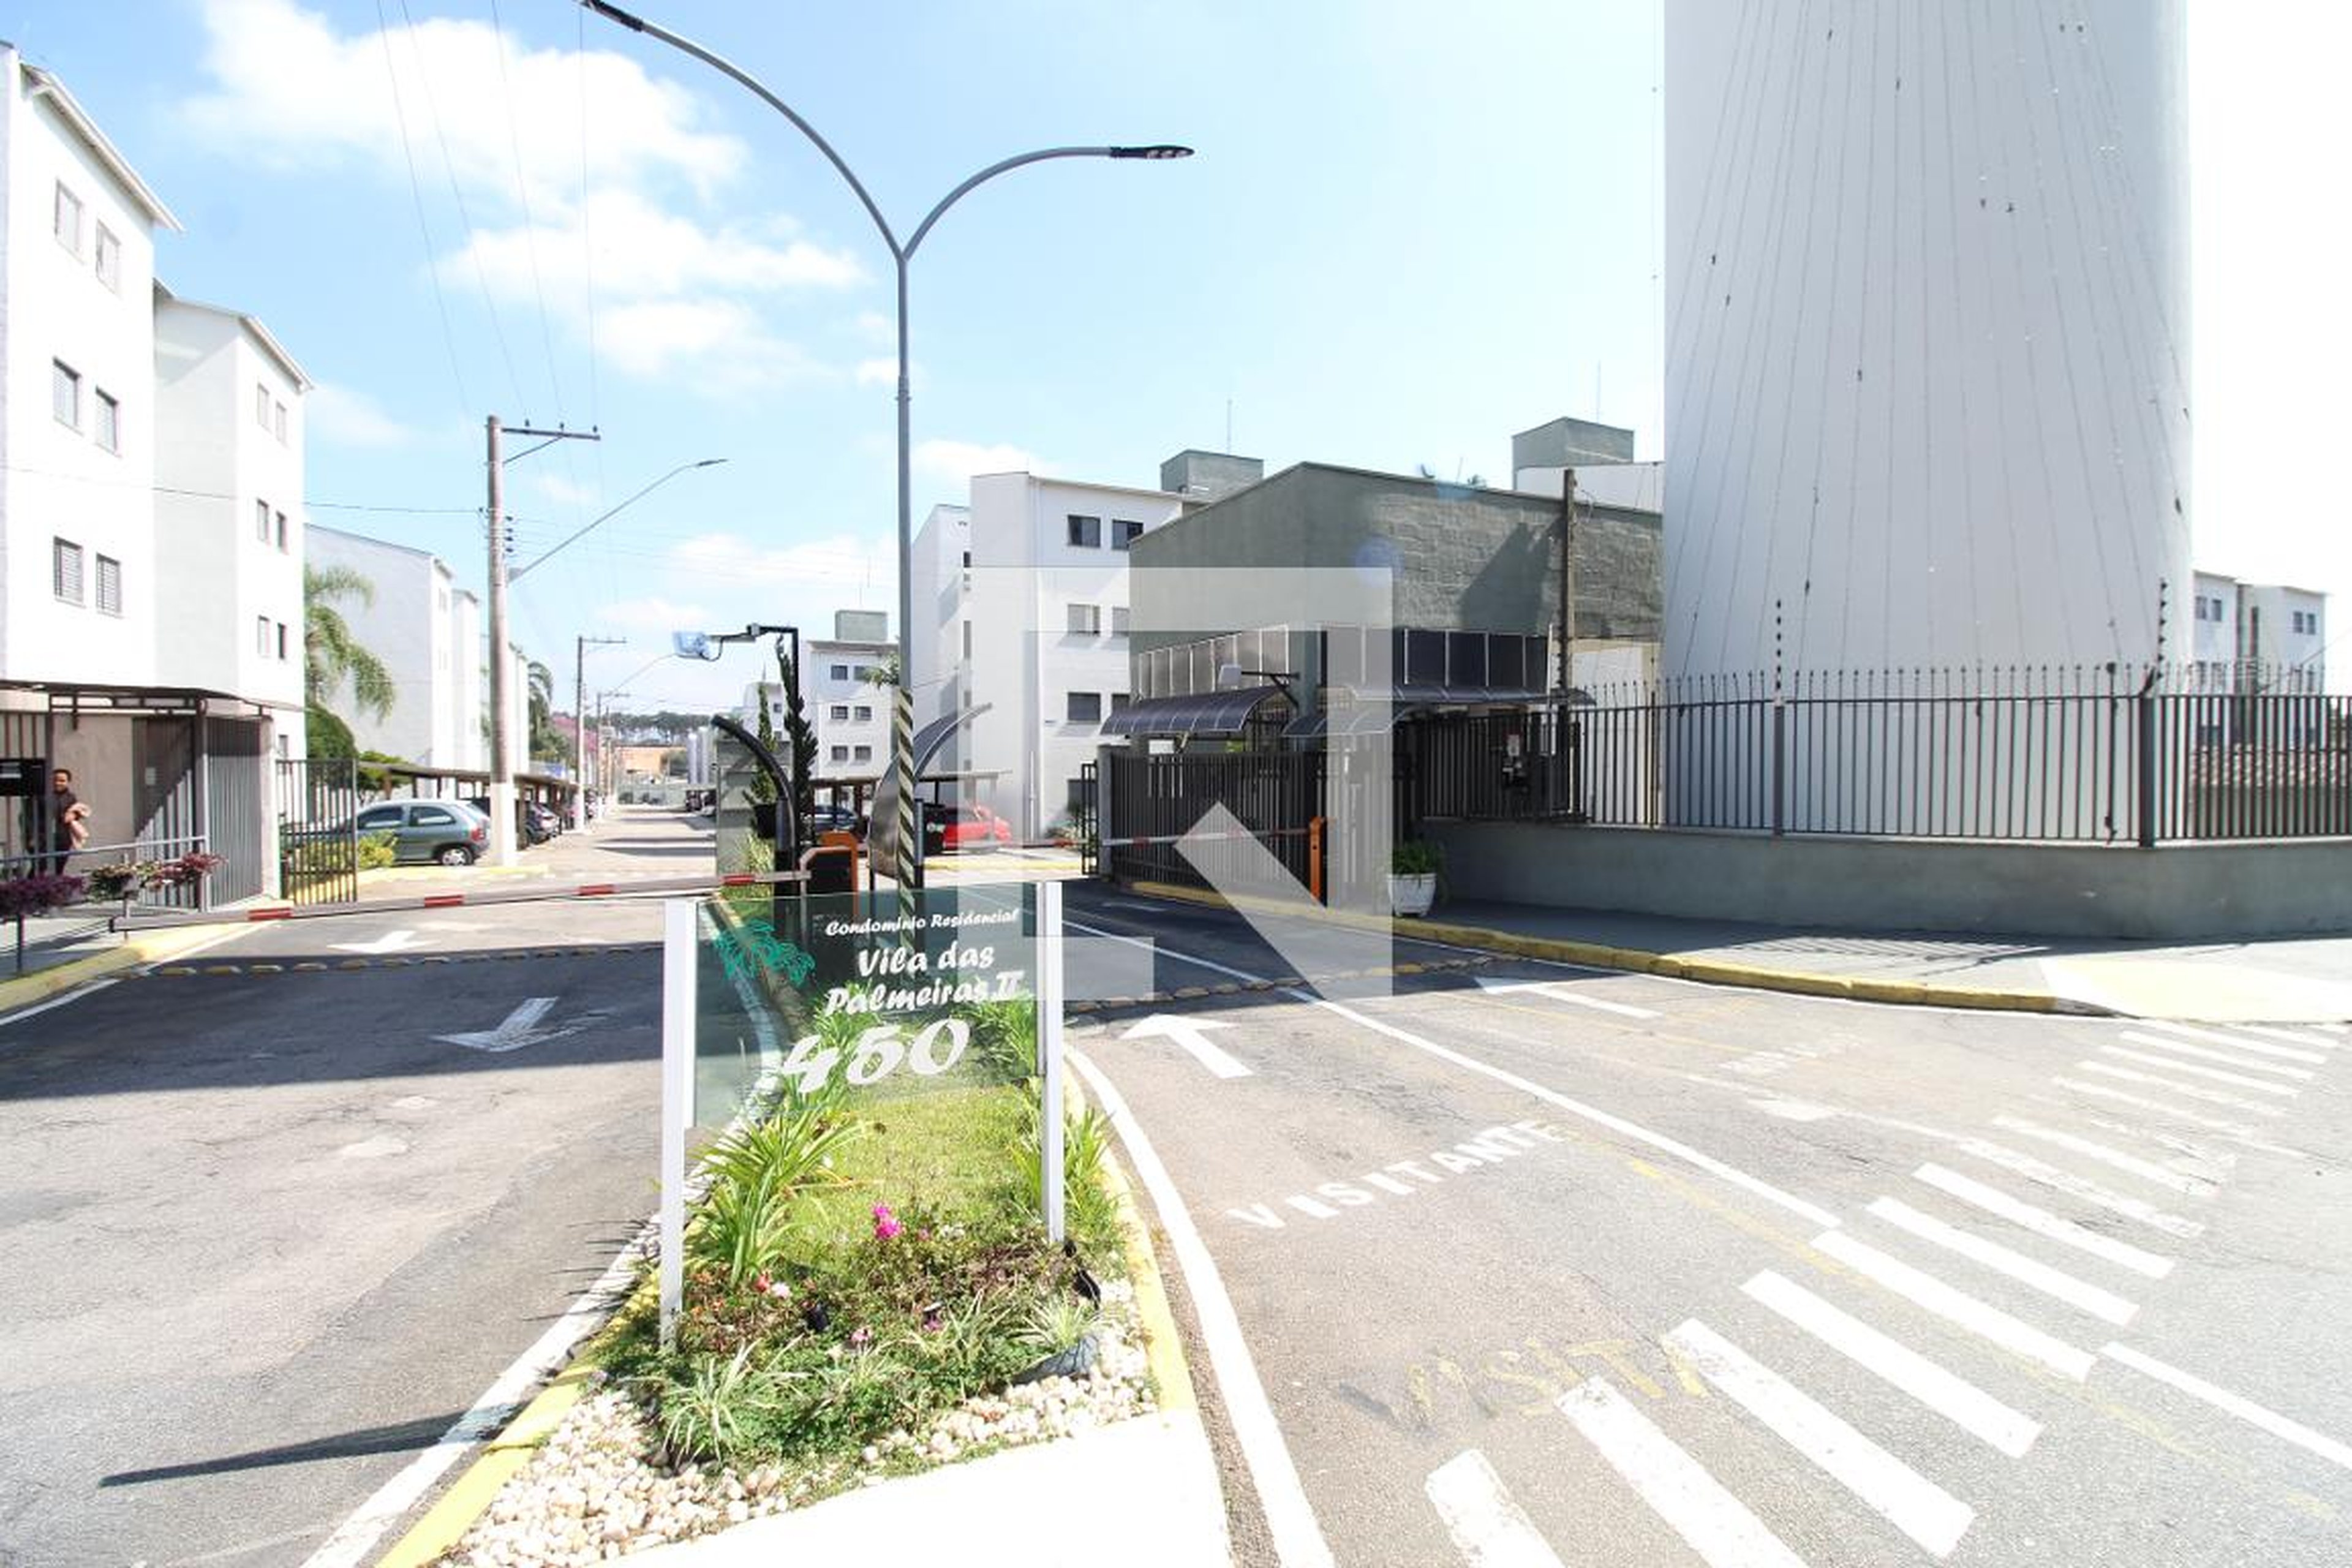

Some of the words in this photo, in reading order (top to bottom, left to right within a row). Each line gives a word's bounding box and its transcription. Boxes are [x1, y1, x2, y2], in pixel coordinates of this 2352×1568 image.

[930, 908, 1020, 927] Residencial
[858, 946, 928, 976] Vila
[937, 940, 995, 970] das
[825, 979, 986, 1015] Palmeiras
[782, 1018, 971, 1094] 460
